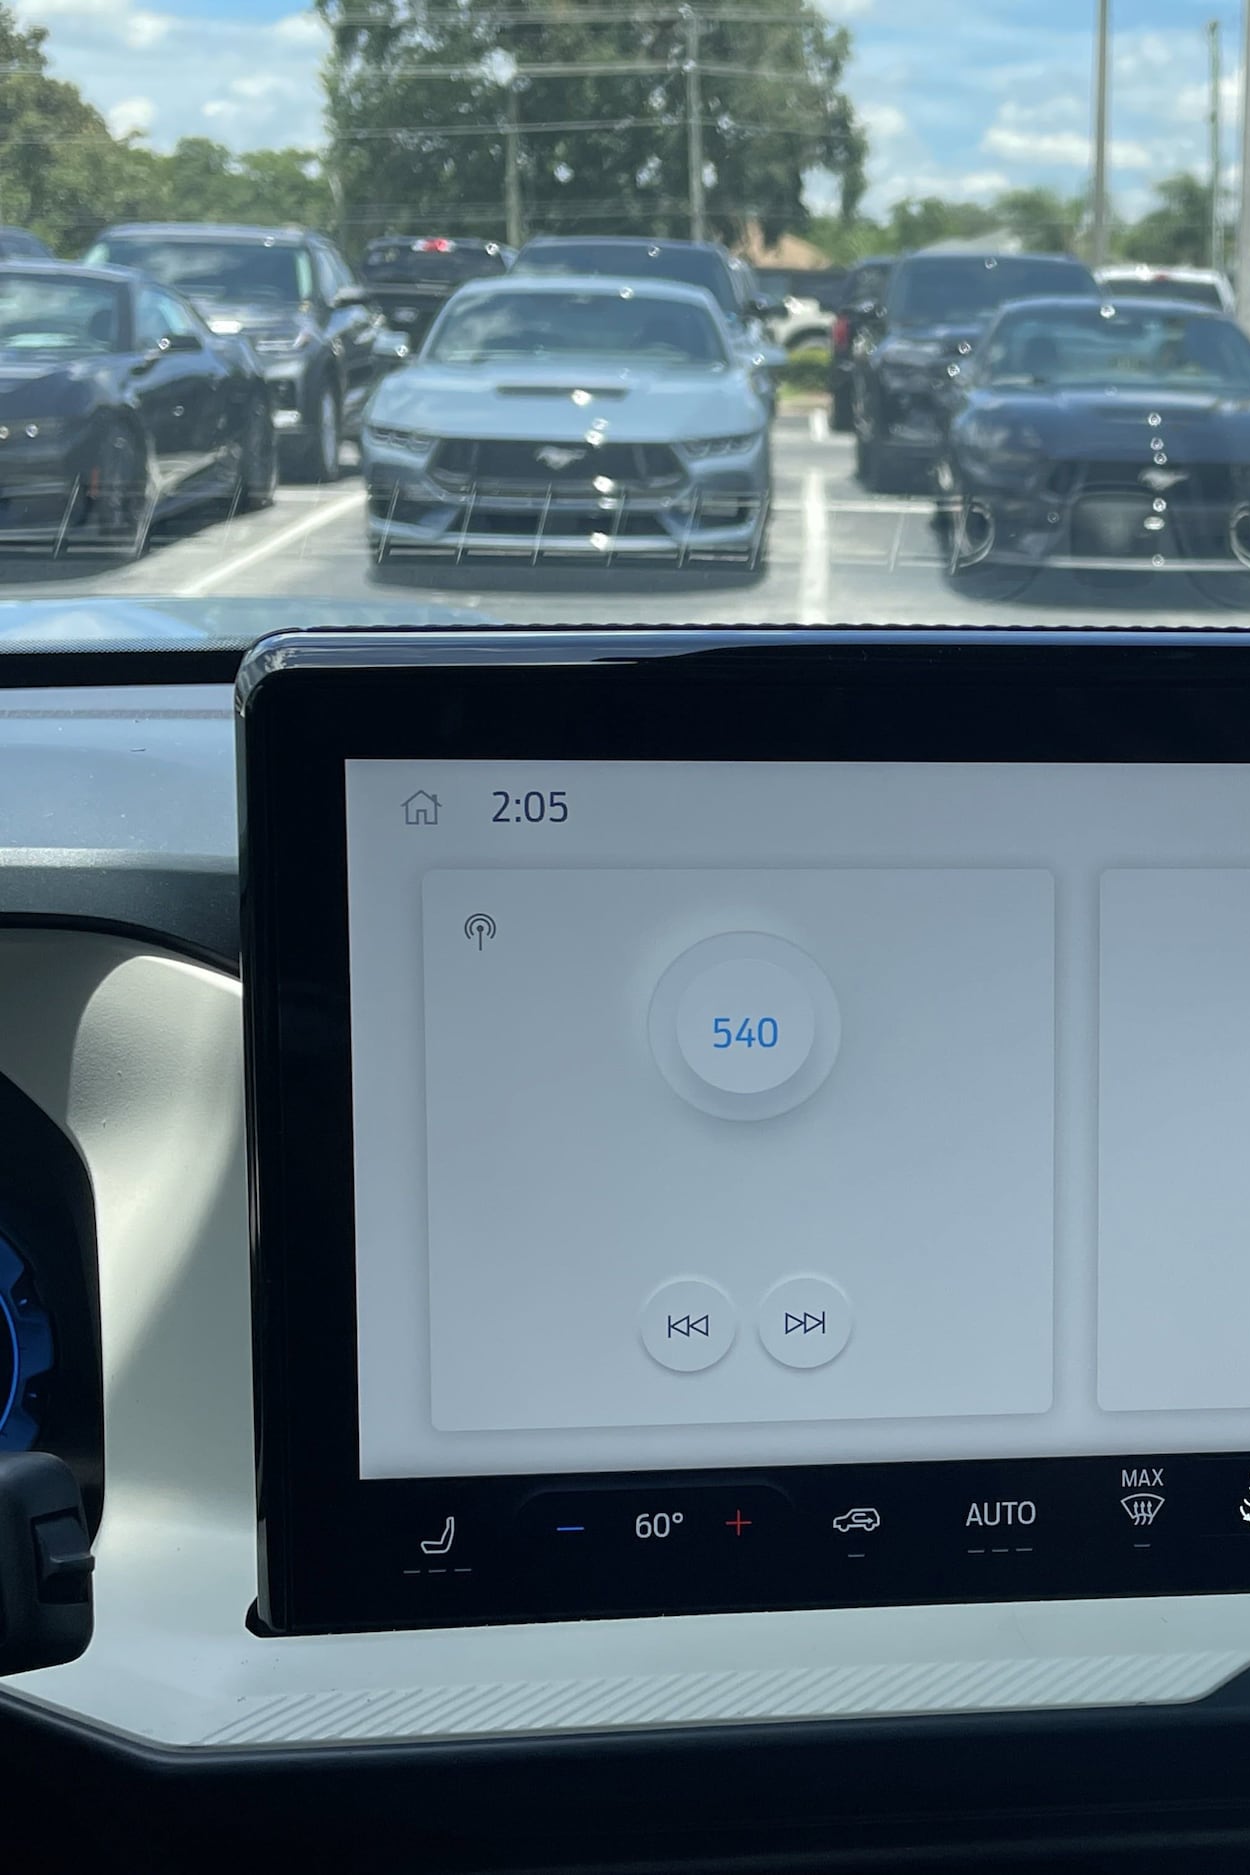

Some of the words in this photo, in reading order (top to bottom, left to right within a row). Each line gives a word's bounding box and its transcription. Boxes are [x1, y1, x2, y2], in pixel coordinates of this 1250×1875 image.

[492, 791, 568, 823] 2:05
[713, 1017, 778, 1049] 540
[1121, 1468, 1164, 1488] MAX
[635, 1512, 684, 1539] 60°
[965, 1500, 1036, 1527] AUTO
